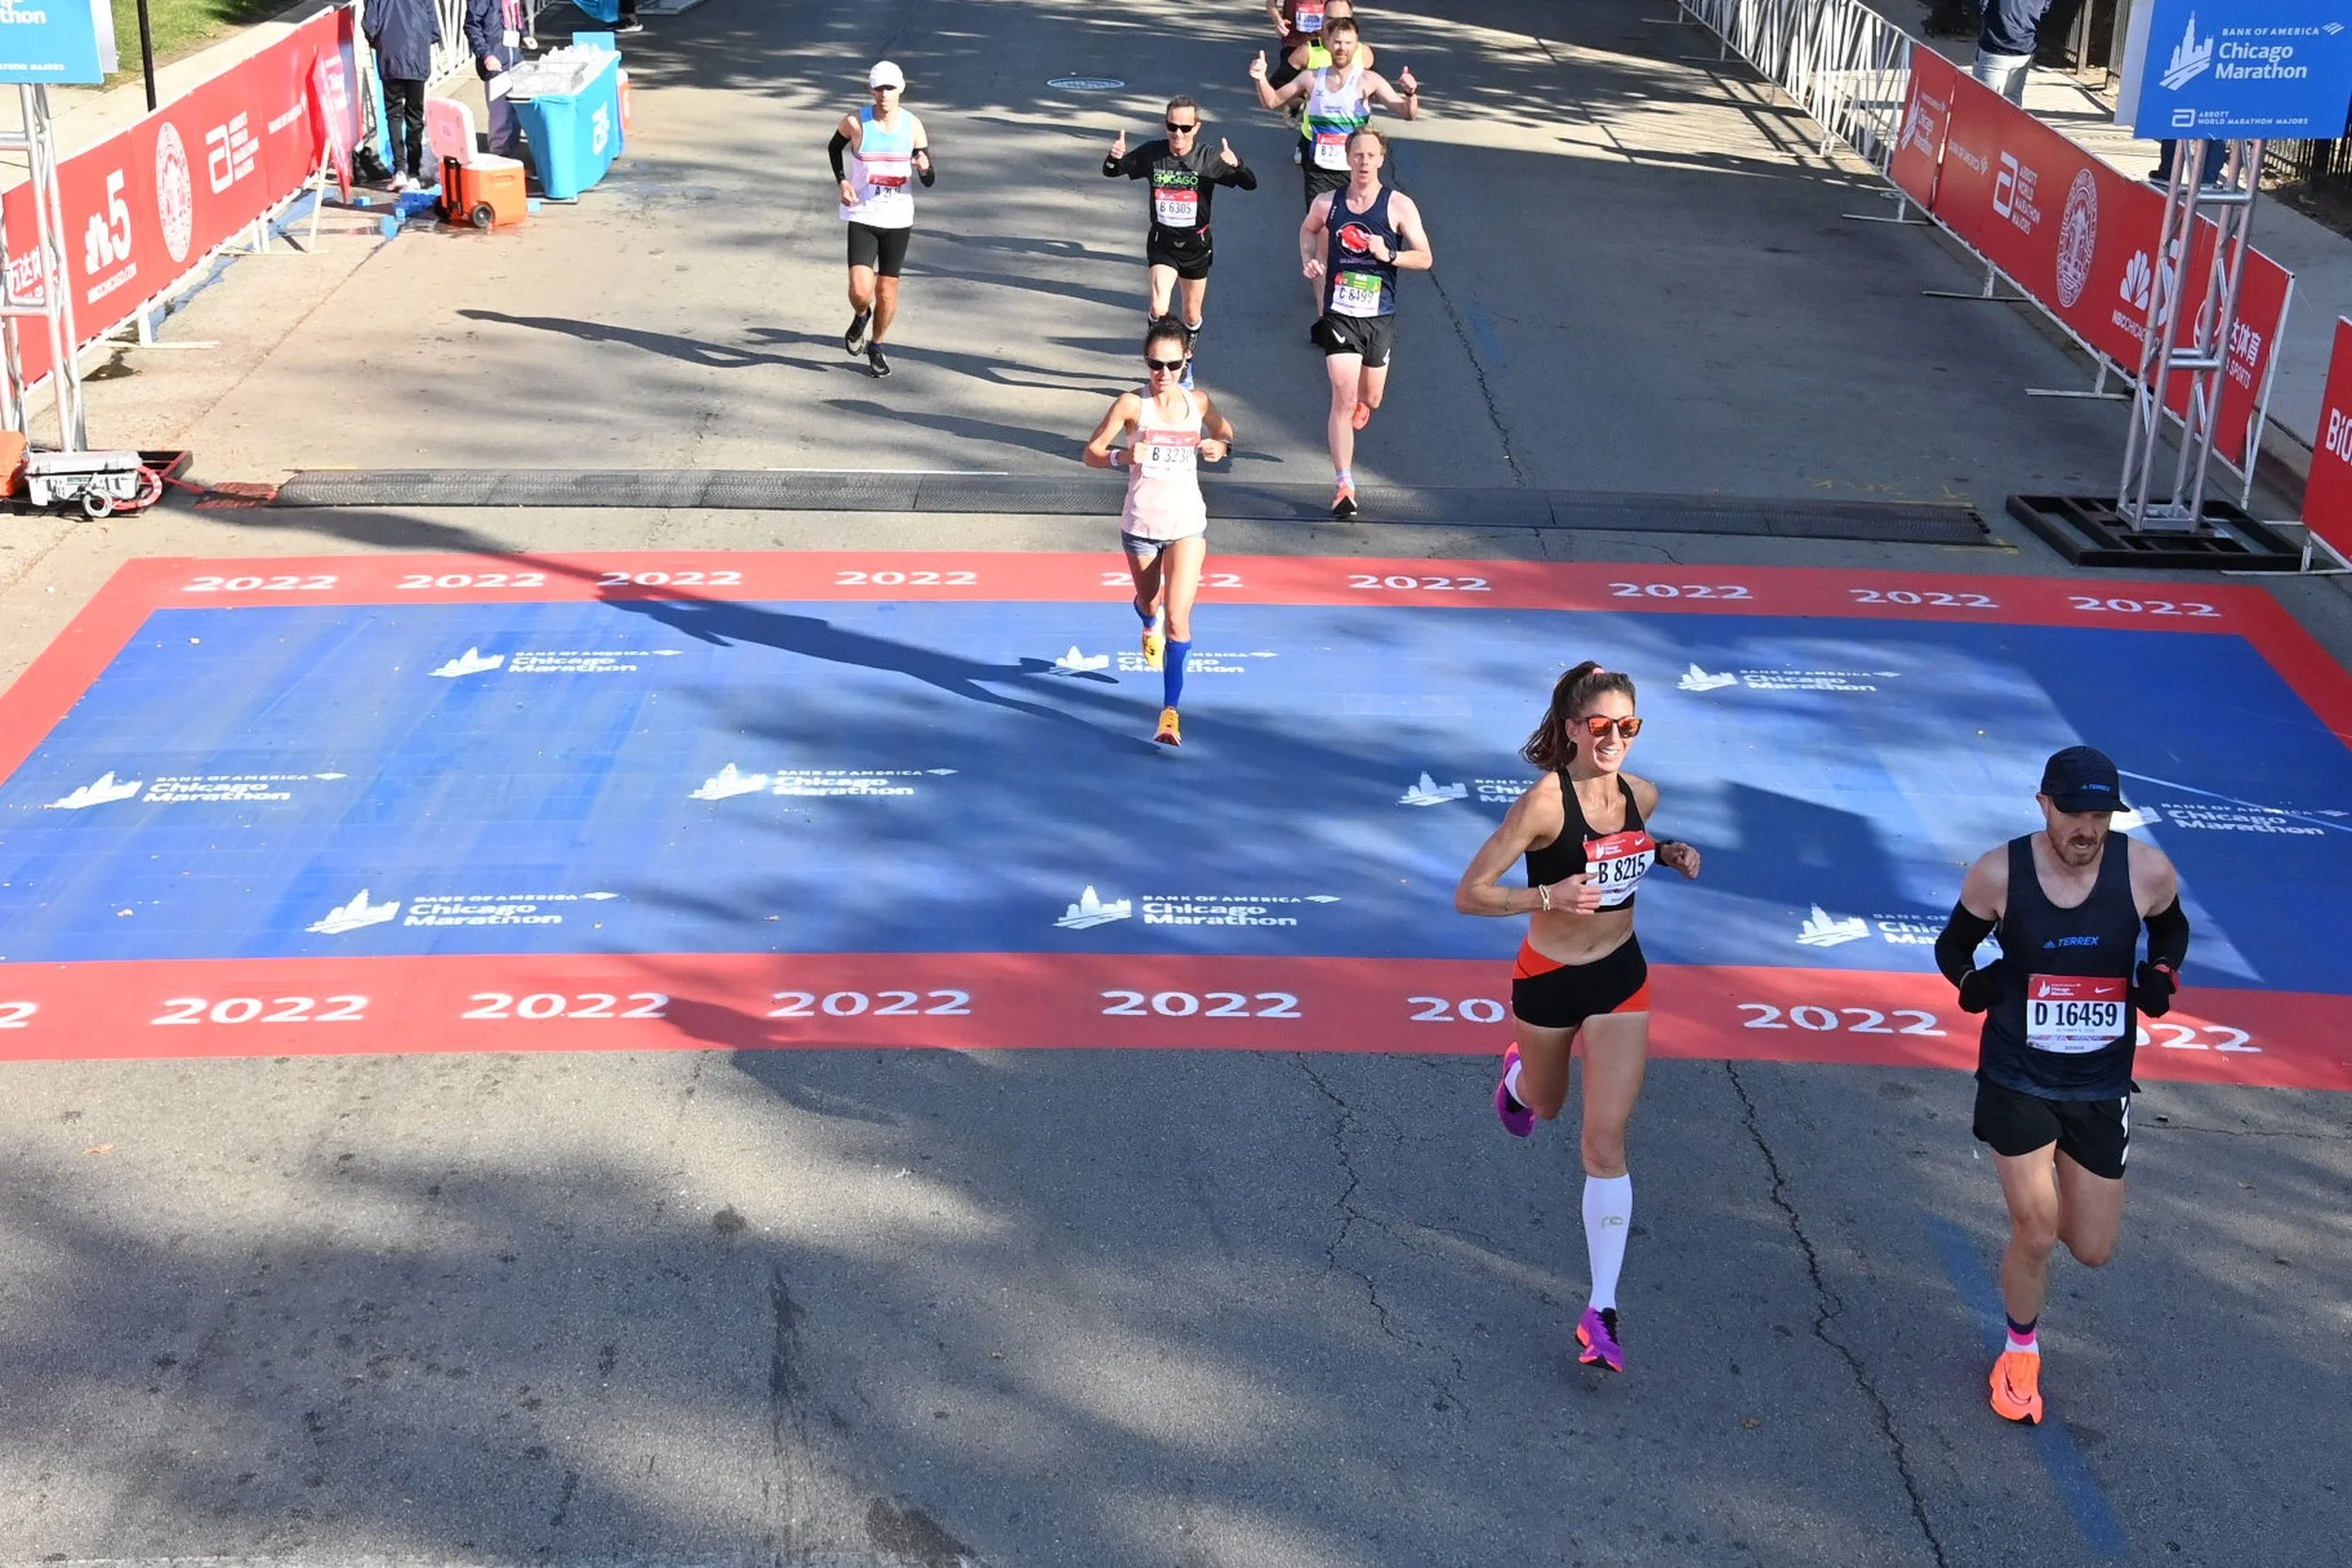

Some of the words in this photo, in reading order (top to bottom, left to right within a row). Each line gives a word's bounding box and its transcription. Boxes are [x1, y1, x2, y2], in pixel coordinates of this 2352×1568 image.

[0, 10, 46, 24] thon
[2270, 27, 2319, 36] AMERICA
[2218, 42, 2294, 63] Chicago
[2215, 63, 2307, 79] Marathon
[1153, 173, 1198, 185] CHICAGO
[106, 168, 132, 260] 5
[1160, 201, 1166, 212] B
[1168, 202, 1192, 214] 6305
[1152, 447, 1160, 461] B
[183, 576, 338, 592] 2022
[397, 573, 546, 589] 2022
[597, 571, 742, 586] 2022
[835, 571, 977, 585] 2022
[1101, 572, 1244, 588] 22
[1349, 575, 1491, 590] 2022
[1609, 582, 1752, 599] 2022
[1851, 589, 1997, 608] 2022
[2069, 596, 2221, 617] 2022
[508, 663, 639, 673] Marathon
[512, 657, 617, 667] Chicago
[1743, 675, 1847, 685] Chicago
[1747, 682, 1876, 691] Marathon
[150, 783, 268, 794] Chicago
[774, 777, 888, 788] Chicago
[142, 791, 292, 802] Marathon
[772, 785, 914, 796] Marathon
[2167, 810, 2286, 825] Chicago
[2175, 819, 2325, 835] Marathon
[1598, 862, 1608, 884] B
[1614, 853, 1645, 882] 8215
[408, 903, 537, 916] Chicago
[1142, 903, 1266, 917] Chicago
[404, 913, 563, 927] Marathon
[1143, 913, 1297, 926] Marathon
[1878, 921, 1945, 933] Chic
[2058, 936, 2099, 947] TERREX
[152, 994, 369, 1025] 2022
[461, 992, 668, 1020] 2022
[766, 990, 971, 1017] 2022
[1101, 990, 1301, 1019] 2022
[1407, 996, 1505, 1023] 20
[1738, 1004, 1948, 1037] 2022
[2137, 1023, 2262, 1053] 22
[2035, 1003, 2047, 1025] D
[2056, 1003, 2117, 1027] 16459
